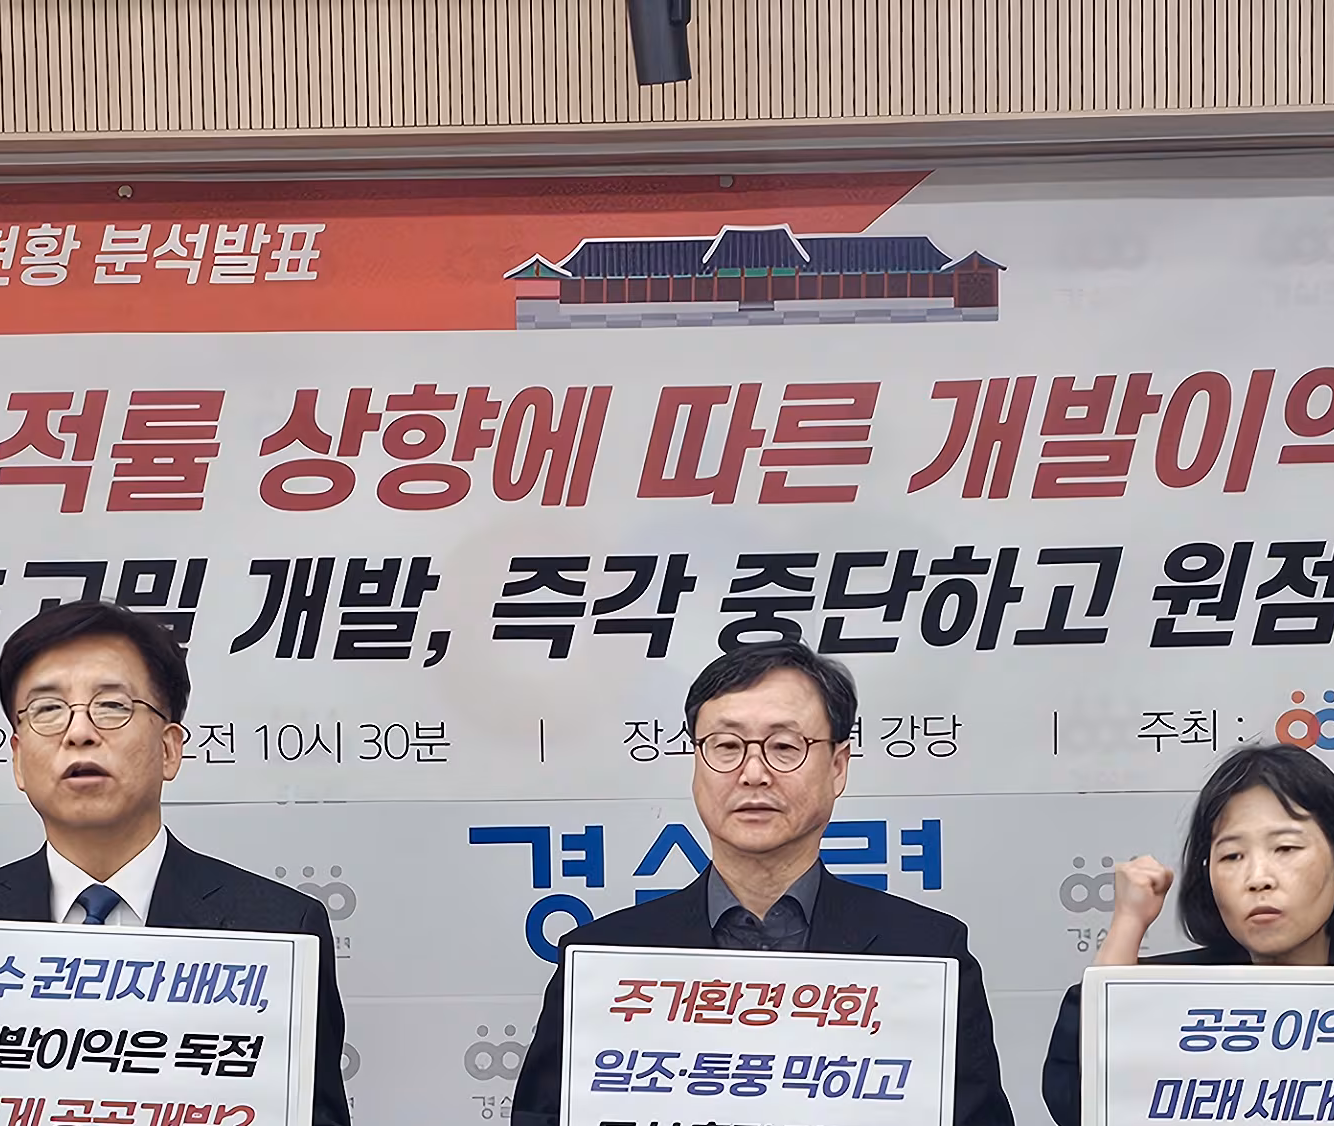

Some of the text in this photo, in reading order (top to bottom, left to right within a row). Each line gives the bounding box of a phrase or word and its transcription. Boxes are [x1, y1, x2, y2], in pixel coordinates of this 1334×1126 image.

[93, 222, 326, 285] 분석발표
[258, 383, 614, 512] 상향에
[636, 381, 882, 505] 따른
[228, 556, 452, 669] 개발,
[491, 552, 698, 660] 즉각
[717, 546, 1124, 655] 중단하고
[254, 721, 342, 764] 10시
[359, 721, 451, 763] 30분
[880, 714, 963, 759] 강당
[1137, 709, 1217, 753] 주최
[469, 819, 941, 964] 경련
[30, 956, 166, 1003] 권리자
[166, 962, 269, 1014] 배제,
[609, 978, 882, 1036] 주거환경 악화,
[173, 1033, 265, 1078] 독점
[1178, 1008, 1268, 1053] 공공
[590, 1049, 913, 1101] 일조·통풍 막히고
[1147, 1078, 1245, 1121] 미래
